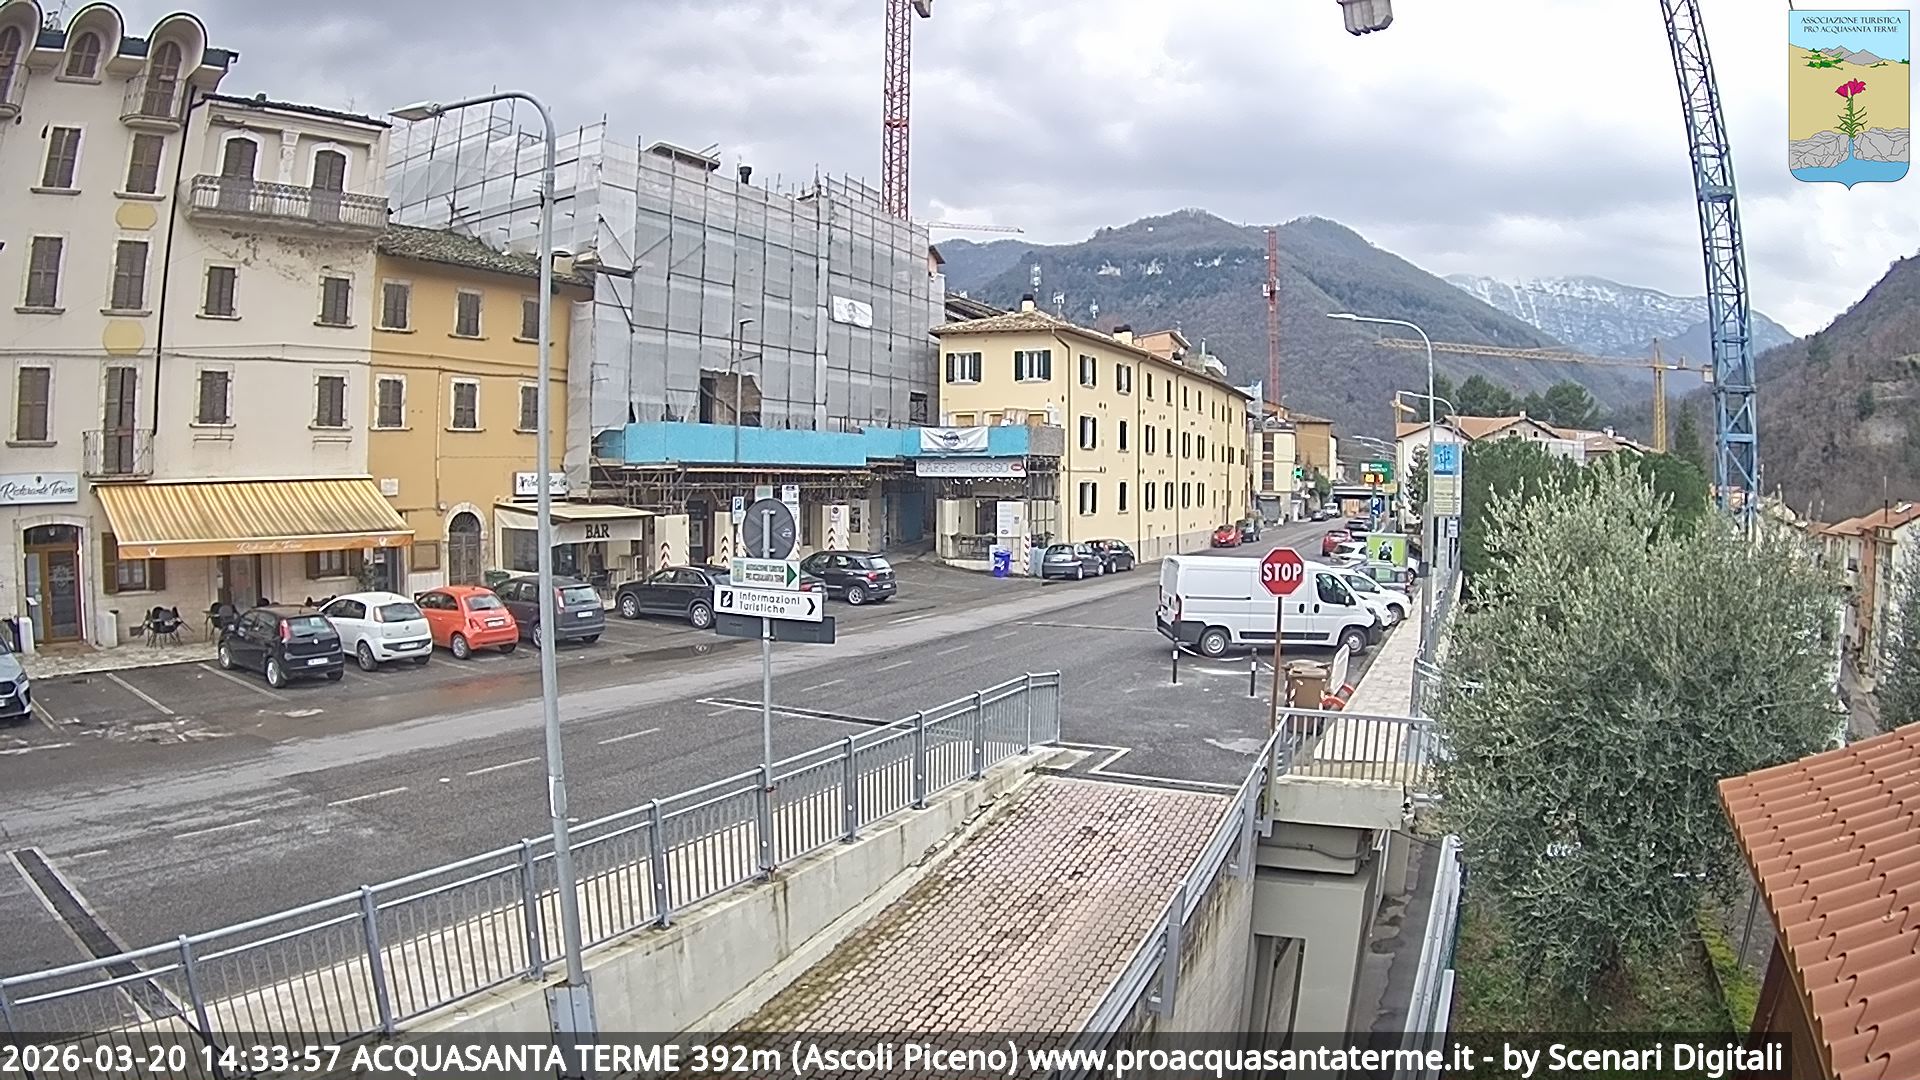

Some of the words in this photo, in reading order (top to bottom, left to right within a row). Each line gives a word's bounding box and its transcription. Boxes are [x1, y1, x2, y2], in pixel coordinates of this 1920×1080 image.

[969, 462, 1009, 474] CORSO
[585, 523, 610, 539] BAR
[1263, 562, 1302, 582] STOP
[739, 591, 800, 605] Informazioni
[739, 602, 786, 615] Turistiche
